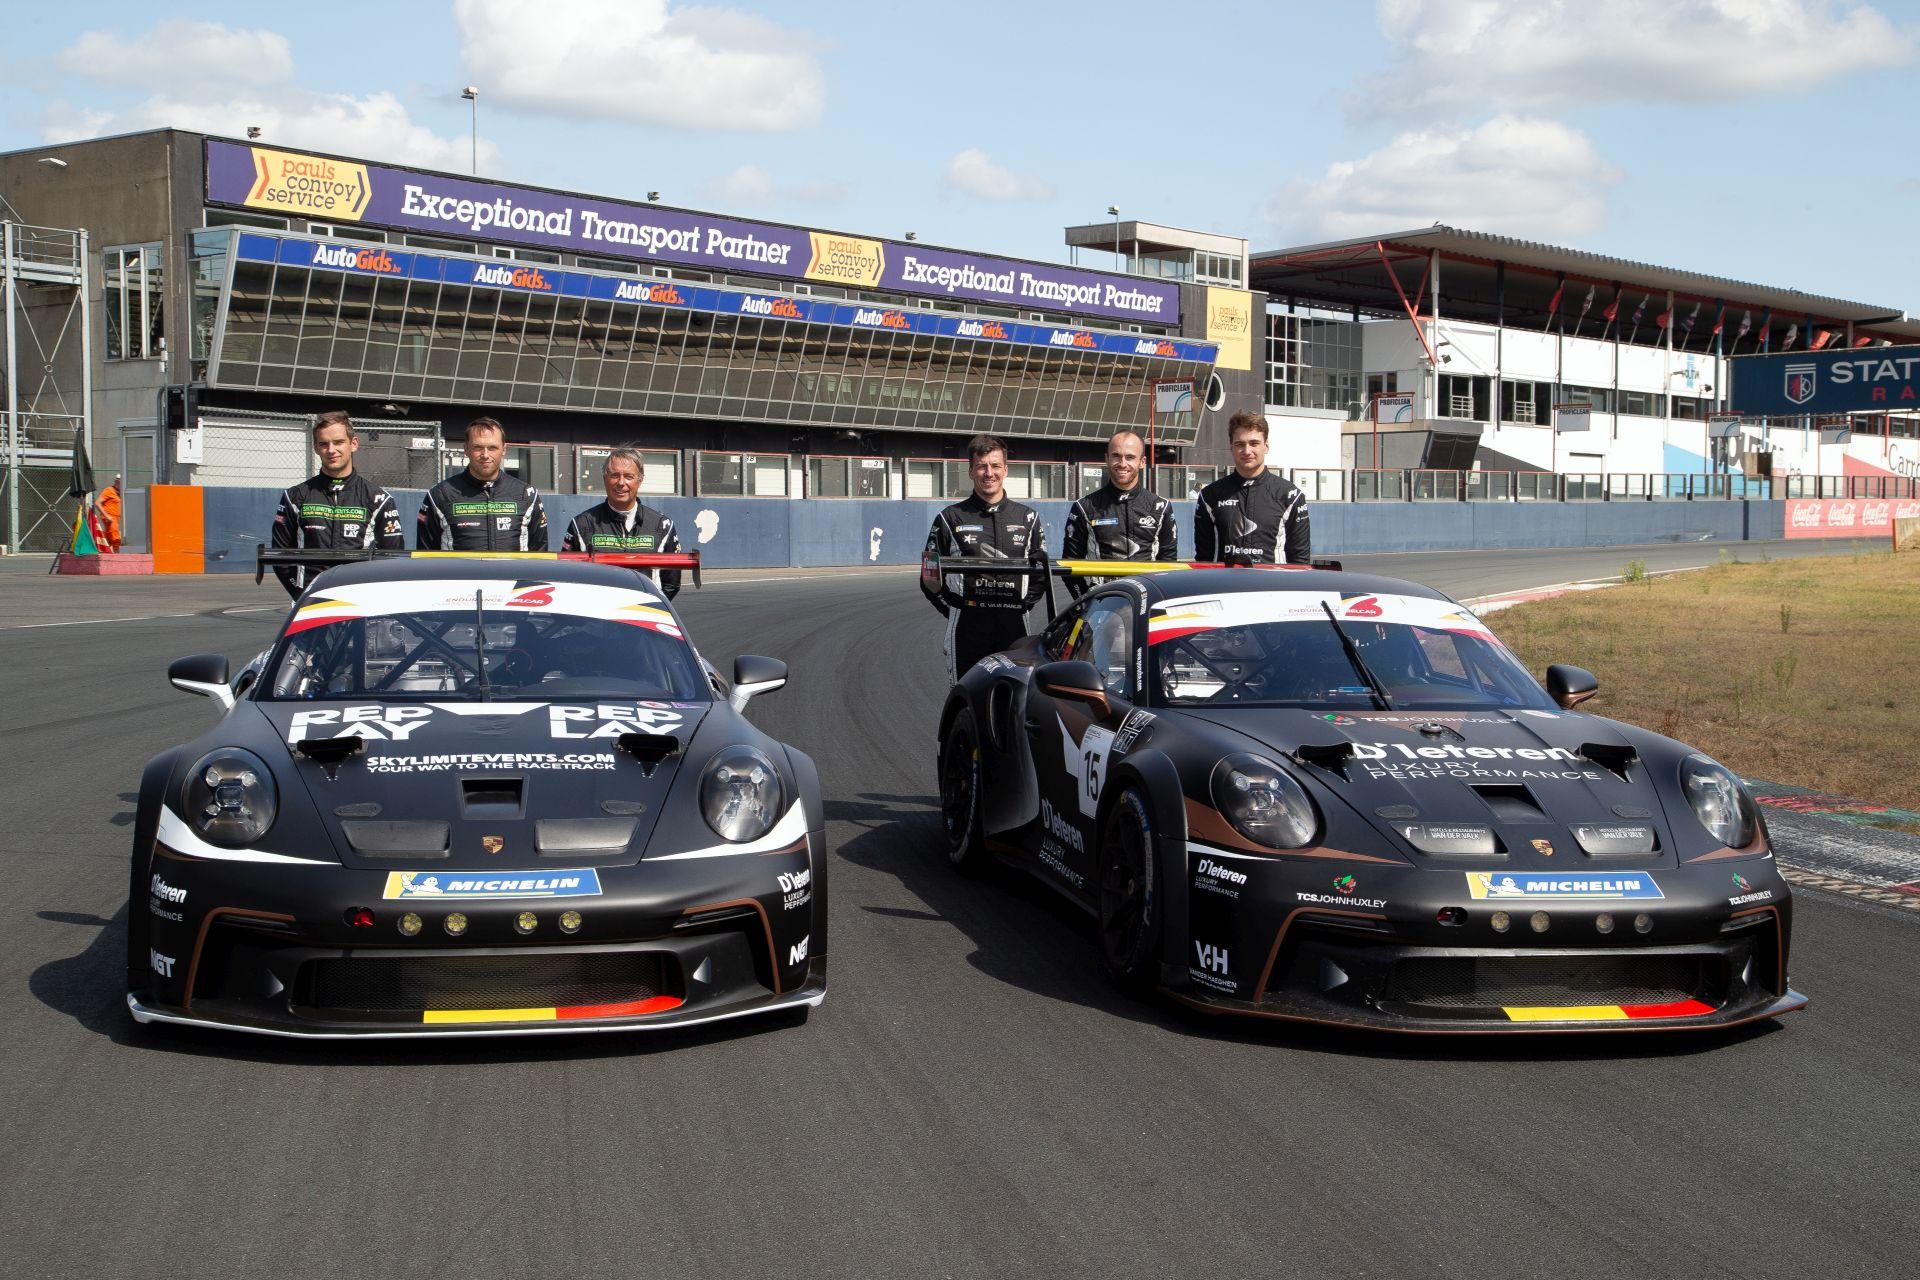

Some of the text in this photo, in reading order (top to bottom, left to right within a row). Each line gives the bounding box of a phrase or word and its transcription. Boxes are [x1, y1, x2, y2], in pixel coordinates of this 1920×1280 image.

[282, 158, 336, 181] pauls
[286, 175, 356, 202] convoy
[266, 188, 336, 209] service
[401, 184, 791, 265] Exceptional Transport Partner
[827, 239, 863, 256] pauls
[831, 251, 876, 271] convoy
[818, 262, 862, 279] service
[902, 256, 1163, 314] Exceptional Transport Partner
[1220, 306, 1238, 316] pauls
[1214, 322, 1238, 332] service
[1157, 384, 1191, 393] PROFICLEAN
[1379, 398, 1411, 406] PROFICLEAN
[1558, 408, 1591, 417] PROFICLEAN
[290, 706, 434, 726] REP
[548, 706, 682, 724] REP
[287, 720, 432, 744] LAY
[550, 719, 682, 739] LAY
[367, 752, 616, 766] SKYLIMITEVENTS.COM
[1352, 742, 1581, 760] D'Ieteren
[367, 764, 408, 773] YOUR
[412, 764, 454, 772] WAY
[522, 762, 616, 770] RACETRACK
[1362, 761, 1480, 771] LUXURY
[1084, 750, 1102, 802] 15
[1370, 770, 1602, 780] PERFORMANCE
[1195, 875, 1218, 886] LUXURY
[1198, 859, 1248, 885] D'Ieteren
[447, 877, 580, 891] MICHELIN
[1195, 881, 1240, 898] PERFORMANCE
[1526, 880, 1640, 892] MICHELIN
[1296, 892, 1387, 908] TCSJOHNHUXLEY
[789, 934, 810, 966] NGT
[150, 947, 176, 977] NGT
